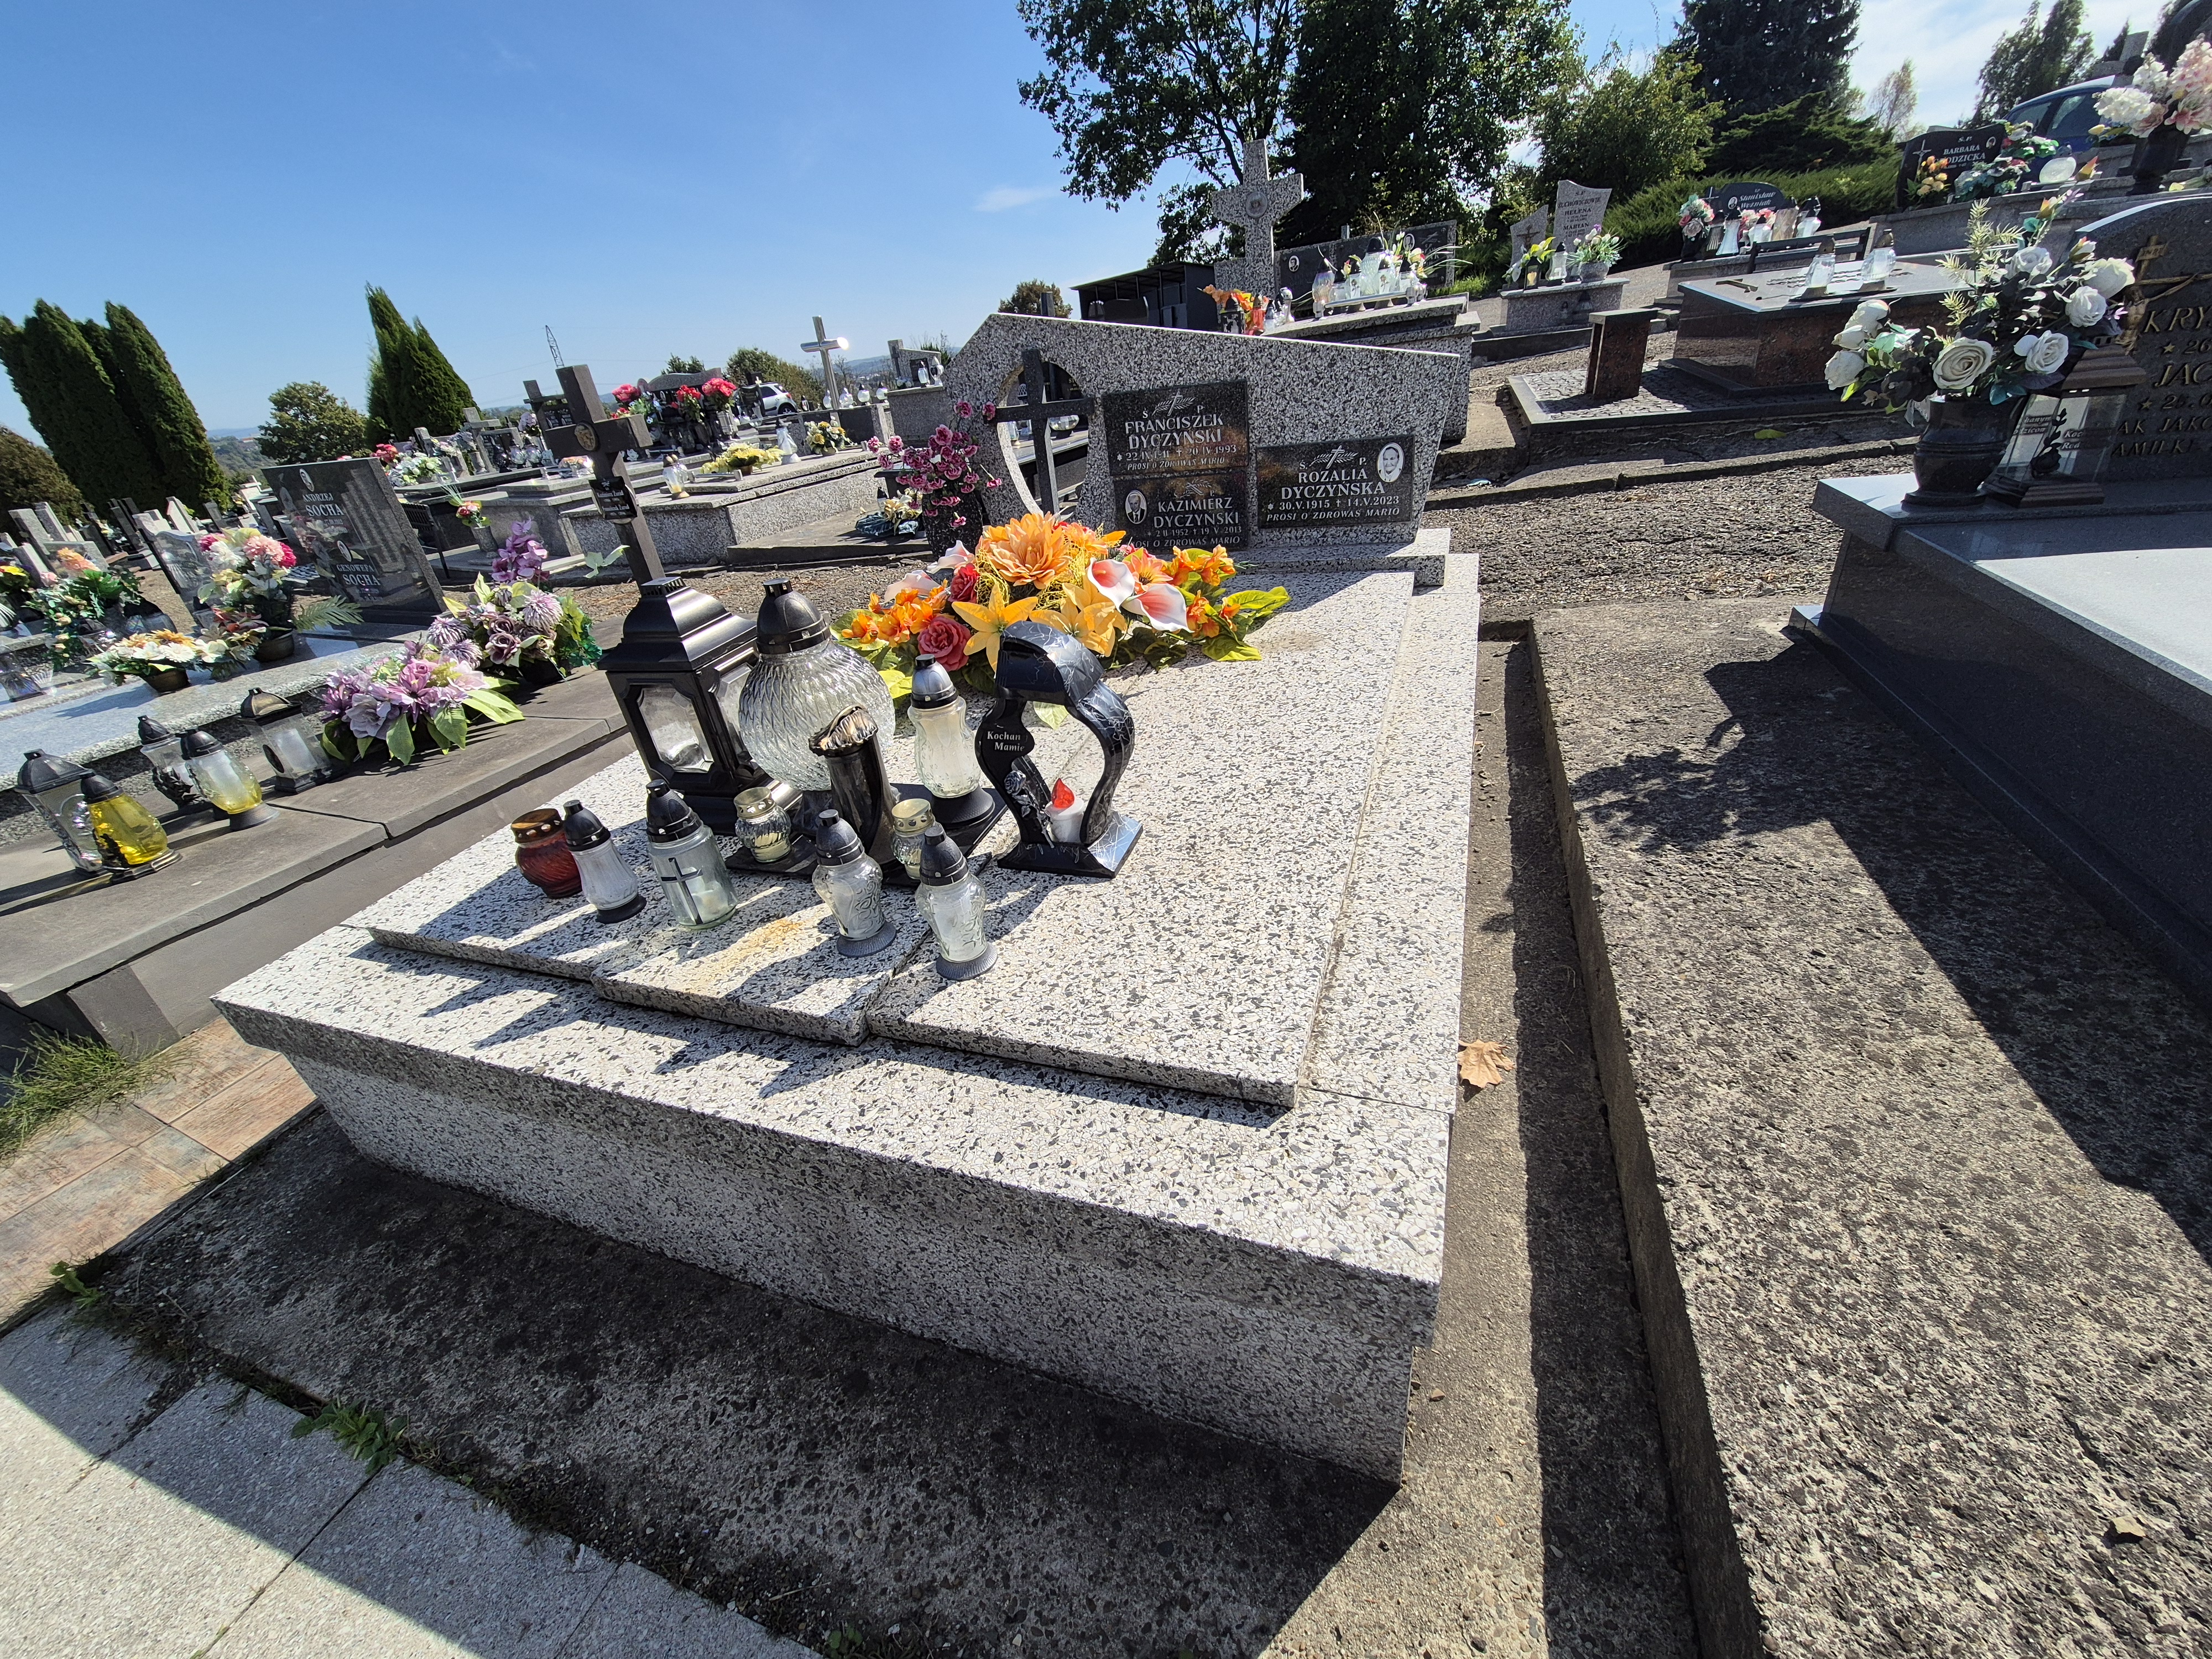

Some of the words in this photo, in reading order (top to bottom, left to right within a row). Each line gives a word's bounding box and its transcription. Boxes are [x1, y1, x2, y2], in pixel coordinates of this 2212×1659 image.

[1943, 144, 1980, 155] BARBARA
[1563, 222, 1590, 231] MARIAN
[1125, 413, 1224, 434] FRANCISZEK
[1127, 462, 1150, 471] PROSI
[1199, 456, 1225, 465] MARIO
[1359, 457, 1367, 466] P.
[1298, 468, 1368, 483] ROZALIA
[1281, 481, 1385, 499] DYCZYŃSKA
[302, 492, 334, 502] ANDRZEJ
[1279, 499, 1331, 510] 30.V.1915
[1347, 495, 1400, 508] 14.V.2023
[305, 503, 345, 517] SOCHA
[1157, 497, 1233, 513] KAZIMIERZ
[1266, 513, 1297, 521] PROSI
[1301, 512, 1308, 520] O
[1365, 508, 1400, 517] MARIO
[1210, 535, 1240, 545] MARIO
[336, 564, 375, 572] GENOWEFA
[342, 573, 381, 586] SOCHA
[994, 742, 1025, 752] Mamie
